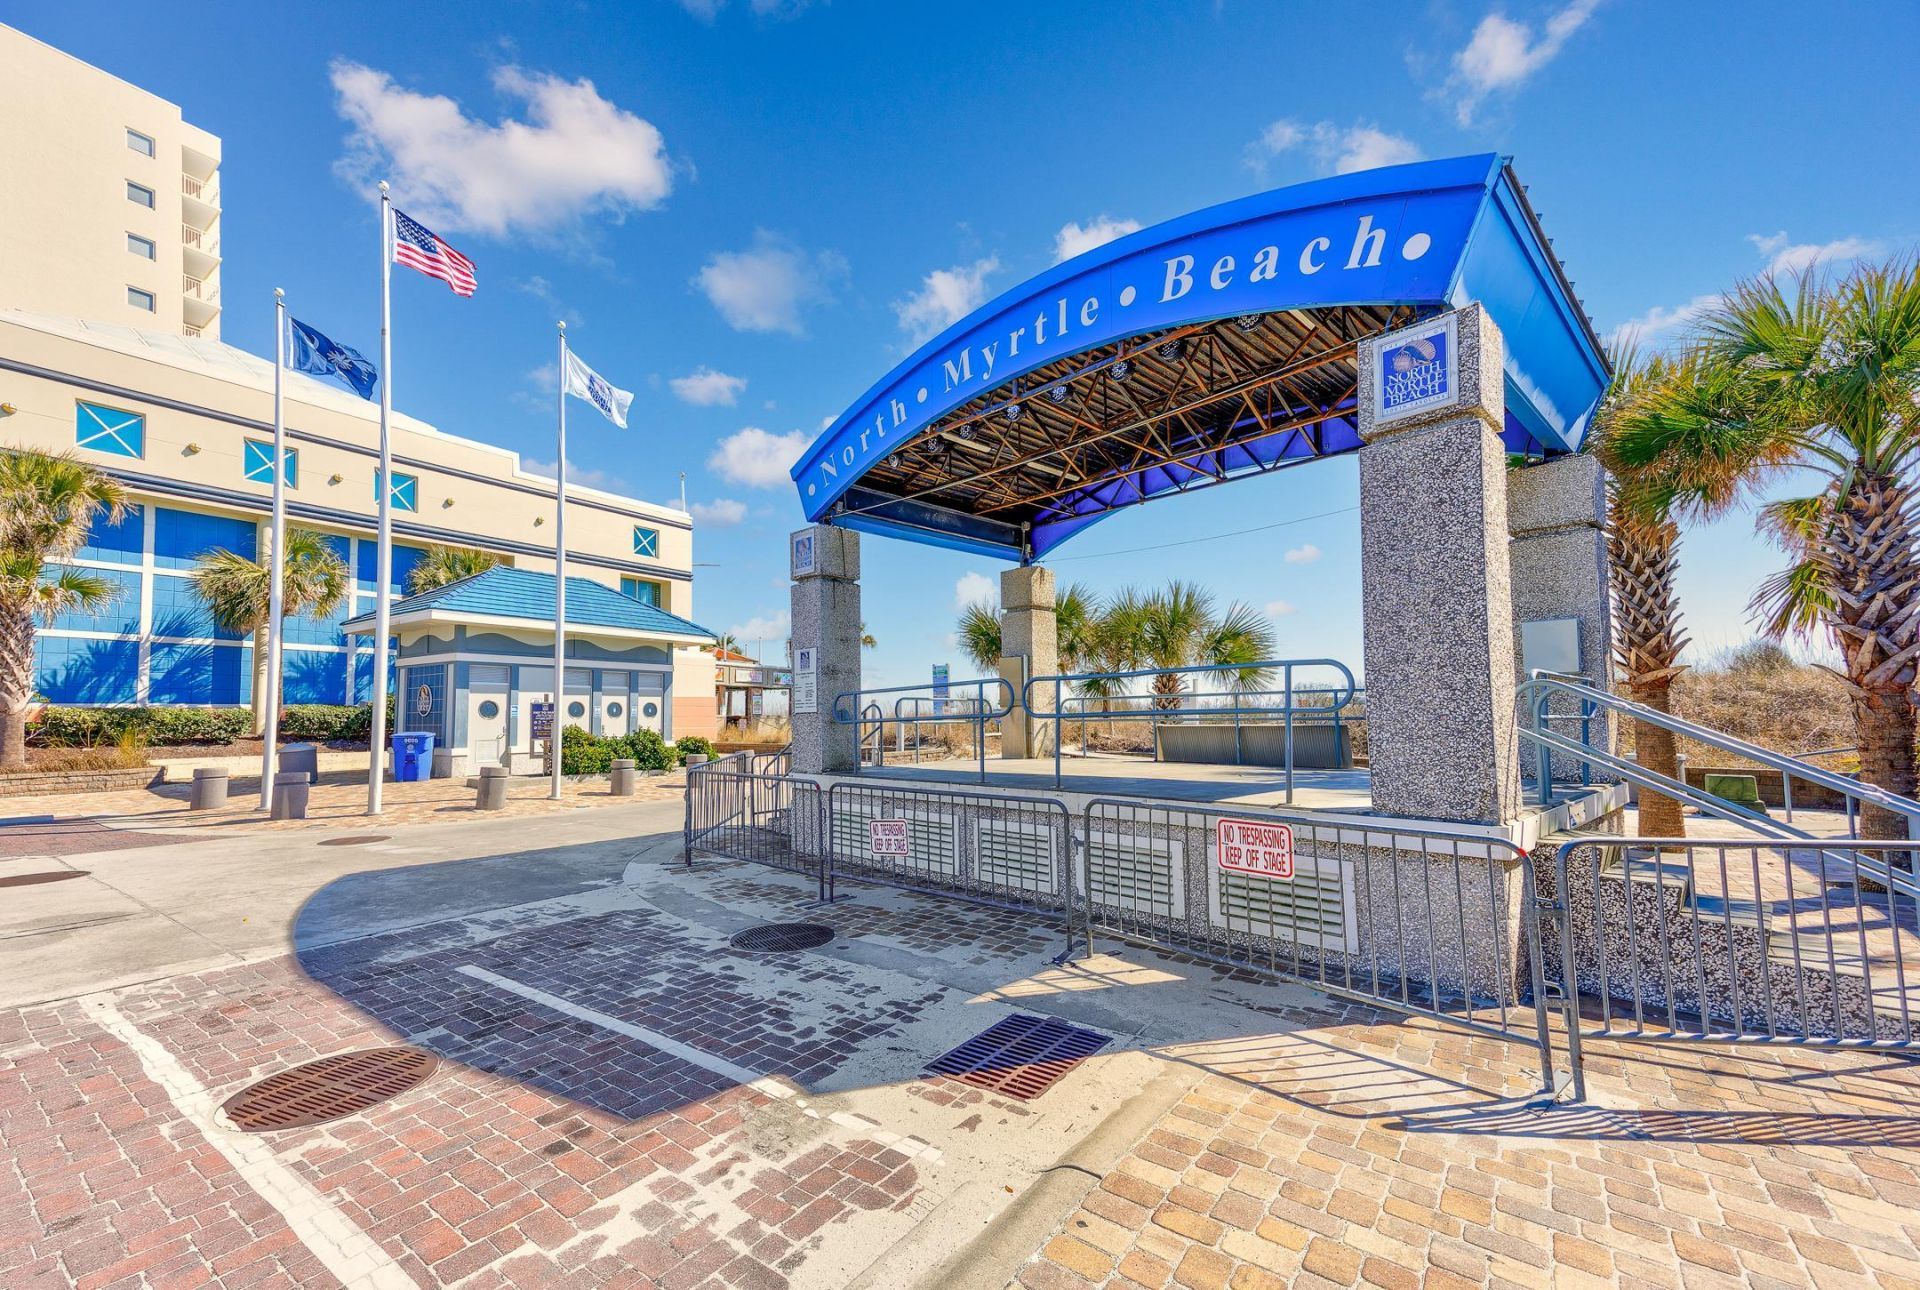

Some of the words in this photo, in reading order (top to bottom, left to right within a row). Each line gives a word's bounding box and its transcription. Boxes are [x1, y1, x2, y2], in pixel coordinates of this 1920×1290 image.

[820, 398, 908, 489] North
[942, 296, 1099, 394] Myrtle
[1158, 214, 1387, 304] Beach
[1383, 370, 1446, 398] MYRTLE
[1387, 360, 1441, 386] NORTH
[1389, 382, 1441, 407] BEACH
[872, 823, 879, 836] NO
[880, 823, 905, 837] TRESPASSING
[1223, 824, 1235, 843] NO
[1237, 825, 1286, 850] TRESPASSING
[874, 838, 883, 851] KEEP
[894, 838, 906, 851] STAGE
[1225, 846, 1242, 866] KEEP
[1246, 848, 1259, 868] OFF
[1263, 850, 1287, 873] STAGE
